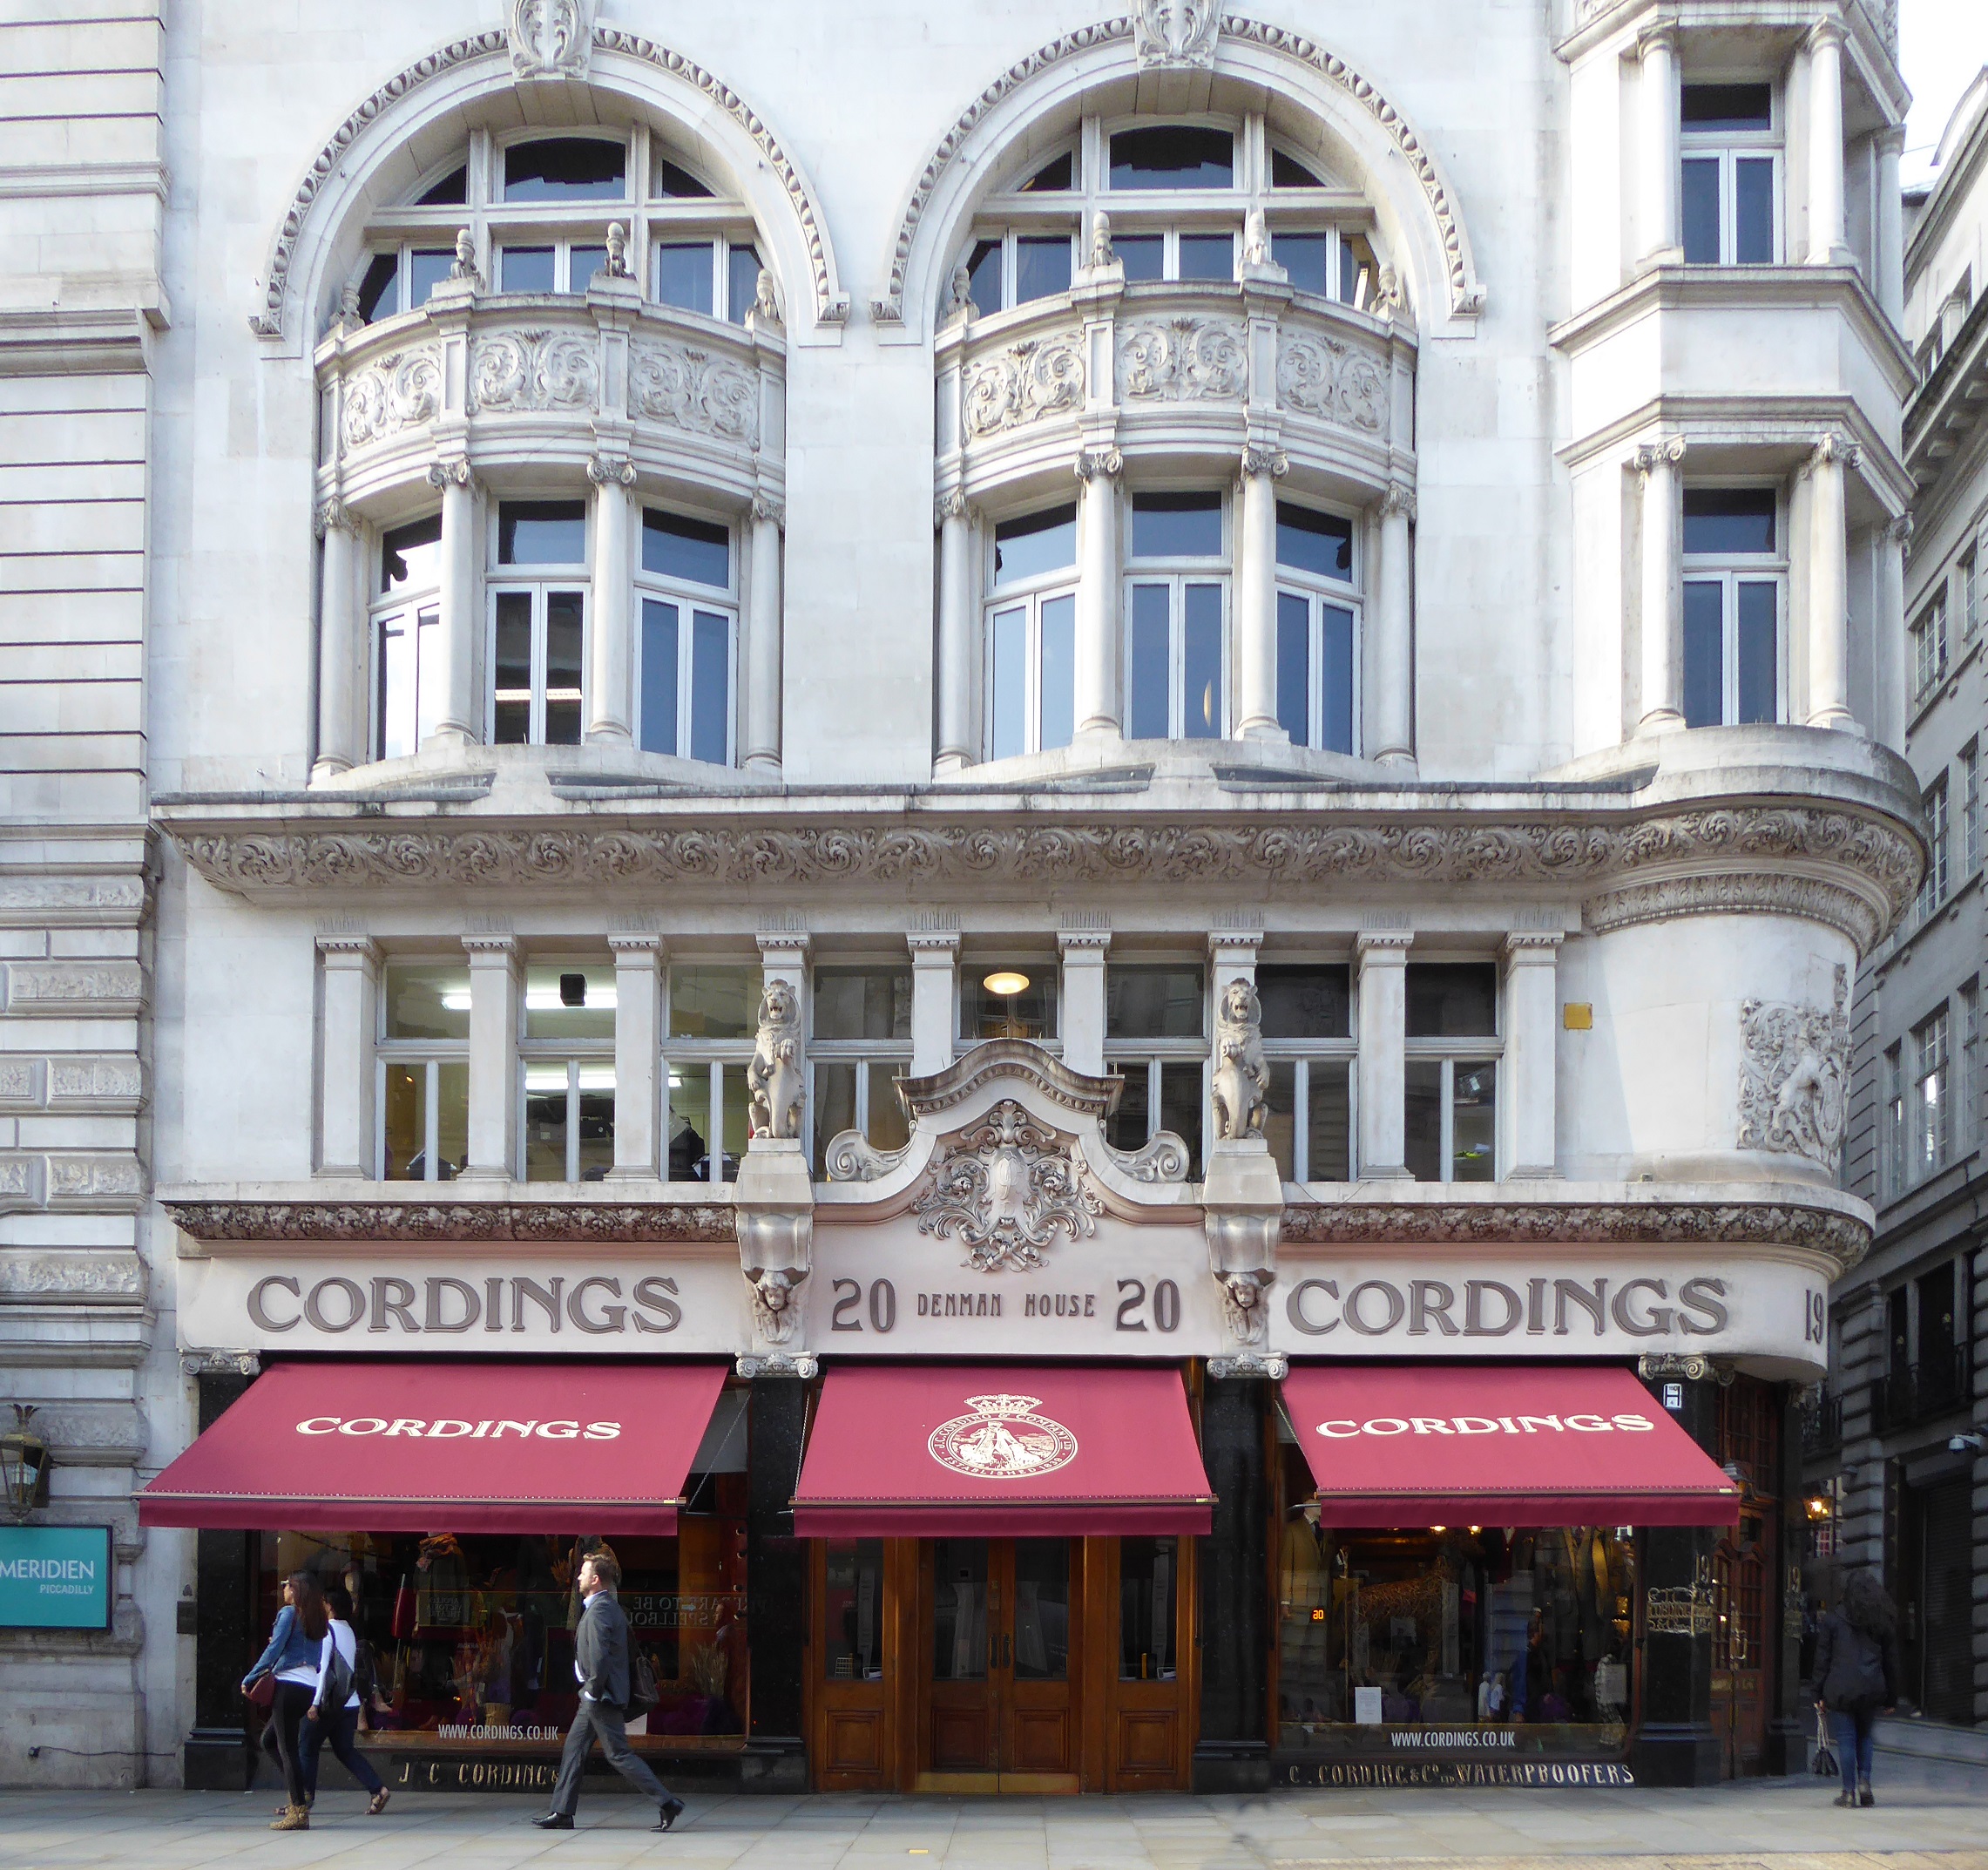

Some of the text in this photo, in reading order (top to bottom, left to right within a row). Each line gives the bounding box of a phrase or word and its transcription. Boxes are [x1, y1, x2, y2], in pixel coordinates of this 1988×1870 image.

[247, 1275, 682, 1335] CORDINGS
[831, 1277, 896, 1333] 20
[917, 1293, 1096, 1318] DENMAN HOUSE
[1115, 1278, 1181, 1333] 20
[1285, 1277, 1729, 1338] CORDINGS
[1805, 1289, 1825, 1345] 19
[294, 1416, 623, 1440] CORDINGS
[1016, 1413, 1070, 1440] COMPANY
[1315, 1413, 1655, 1438] CORDINGS
[943, 1456, 1037, 1476] ESTABLISHED
[0, 1559, 95, 1579] MERIDIEN
[39, 1583, 94, 1595] PICCADILLY
[438, 1724, 559, 1741] WWW.CORDINGS.CO.UK
[1390, 1731, 1516, 1748] WWW.CORDINGS.CO.UK
